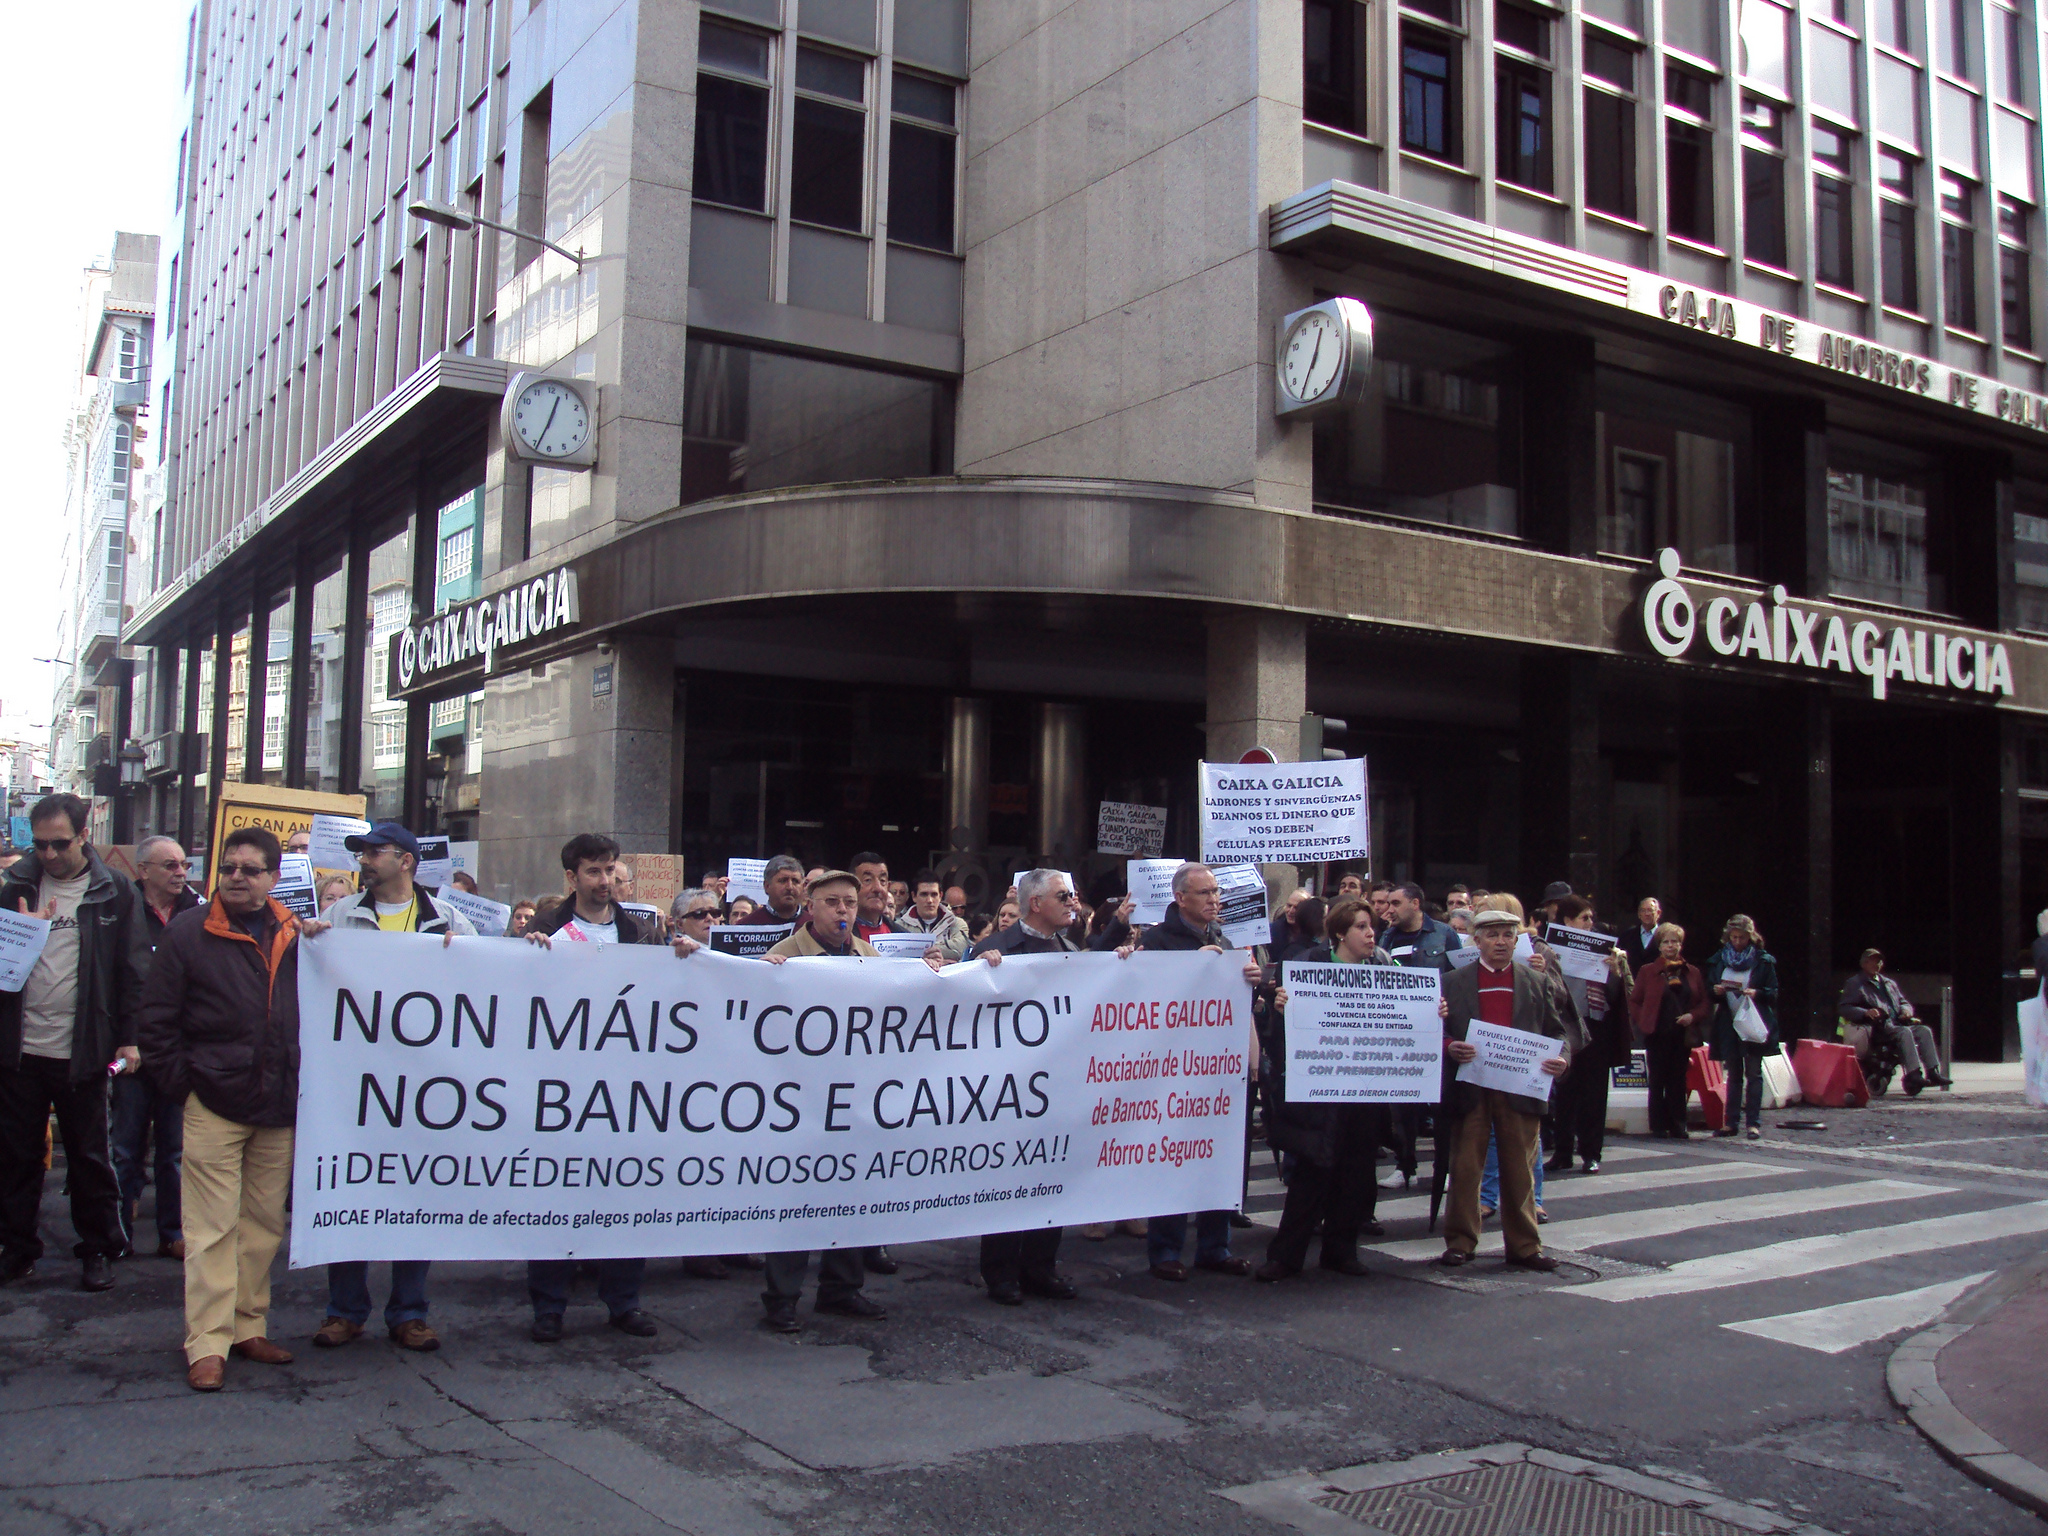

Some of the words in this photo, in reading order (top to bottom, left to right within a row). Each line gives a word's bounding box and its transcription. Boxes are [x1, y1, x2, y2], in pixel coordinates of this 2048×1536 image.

[1659, 285, 1736, 339] CAJA
[1760, 313, 1795, 355] DE
[1818, 333, 1930, 394] AHORROS
[1949, 372, 1978, 409] DE
[1217, 779, 1268, 791] CAIXA
[1272, 776, 1343, 790] GALICIA
[1205, 797, 1261, 806] LADRONES
[1264, 798, 1271, 806] Y
[1274, 793, 1362, 806] SINVERGÜENZAS
[1211, 812, 1263, 821] DEANNOS
[1265, 812, 1279, 820] EL
[1282, 809, 1328, 820] DINERO
[1331, 807, 1355, 819] QUE
[232, 815, 248, 828] C/
[252, 818, 284, 832] SAN
[1248, 826, 1271, 834] NOS
[1274, 824, 1314, 834] DEBEN
[1217, 840, 1265, 849] CELULAS
[1268, 835, 1351, 848] PREFERENTES
[1205, 854, 1262, 863] LADRONES
[1265, 854, 1273, 862] Y
[1276, 849, 1366, 862] DELINCUENTES
[723, 934, 733, 943] EL
[1568, 941, 1591, 951] ESPAÑOL
[1290, 968, 1372, 989] PARTICIPACIONES
[1374, 970, 1436, 989] PREFERENTES
[1295, 990, 1318, 998] PERFIL
[1334, 992, 1363, 1000] CLIENTE
[1377, 1002, 1395, 1010] AÑOS
[333, 988, 498, 1048] NON
[527, 984, 699, 1054] MÁIS
[725, 995, 1071, 1057] "CORRALITO"
[1091, 1002, 1160, 1032] ADICAE
[1165, 999, 1233, 1029] GALICIA
[1368, 1012, 1407, 1020] ECONÓMICA
[1319, 1036, 1350, 1046] PARA
[1352, 1036, 1415, 1047] NOSOTROS:
[1477, 1029, 1512, 1042] DEVUELVE
[1522, 1039, 1550, 1051] DINERO
[1294, 1049, 1343, 1060] ENGAÑO
[1352, 1051, 1393, 1062] ESTAFA
[1401, 1052, 1438, 1063] ABUSO
[1493, 1042, 1506, 1051] TUS
[1507, 1046, 1537, 1057] CLIENTES
[1494, 1053, 1530, 1064] AMORTIZA
[1086, 1051, 1159, 1084] Asociación
[1161, 1049, 1178, 1077] de
[1183, 1048, 1242, 1076] Usuarios
[1308, 1065, 1334, 1075] CON
[1335, 1065, 1424, 1076] PREMEDITACIÓN
[1484, 1060, 1529, 1074] PREFERENTES
[1309, 1088, 1340, 1097] (HASTA
[1341, 1089, 1357, 1097] LES
[1358, 1089, 1389, 1097] DIERON
[1389, 1089, 1421, 1098] CURSOS)
[357, 1073, 507, 1132] NOS
[534, 1079, 801, 1133] BANCOS
[824, 1083, 855, 1132] E
[873, 1070, 1050, 1130] CAIXAS
[1092, 1097, 1109, 1126] de
[1111, 1097, 1162, 1125] Bancos,
[1167, 1091, 1210, 1119] Caixas
[1213, 1088, 1231, 1116] de
[1097, 1138, 1144, 1168] Aforro
[1147, 1142, 1155, 1164] e
[1160, 1136, 1214, 1168] Seguros
[315, 1148, 665, 1191] ¡¡DEVOLVÉDENOS
[677, 1156, 725, 1187] OS
[737, 1152, 857, 1186] NOSOS
[865, 1141, 1005, 1181] AFORROS
[1011, 1134, 1070, 1168] XA!!
[312, 1208, 369, 1229] ADICAE
[374, 1208, 464, 1226] Plataforma
[468, 1209, 488, 1226] de
[492, 1210, 569, 1227] afectados
[572, 1210, 629, 1229] galegos
[633, 1208, 672, 1228] polas
[677, 1204, 776, 1226] participacións
[780, 1201, 855, 1223] preferentes
[859, 1205, 867, 1216] e
[870, 1199, 910, 1215] outros
[913, 1193, 971, 1214] productos
[973, 1188, 1012, 1205] tóxicos
[1015, 1186, 1028, 1200] de
[1030, 1183, 1063, 1198] aforro
